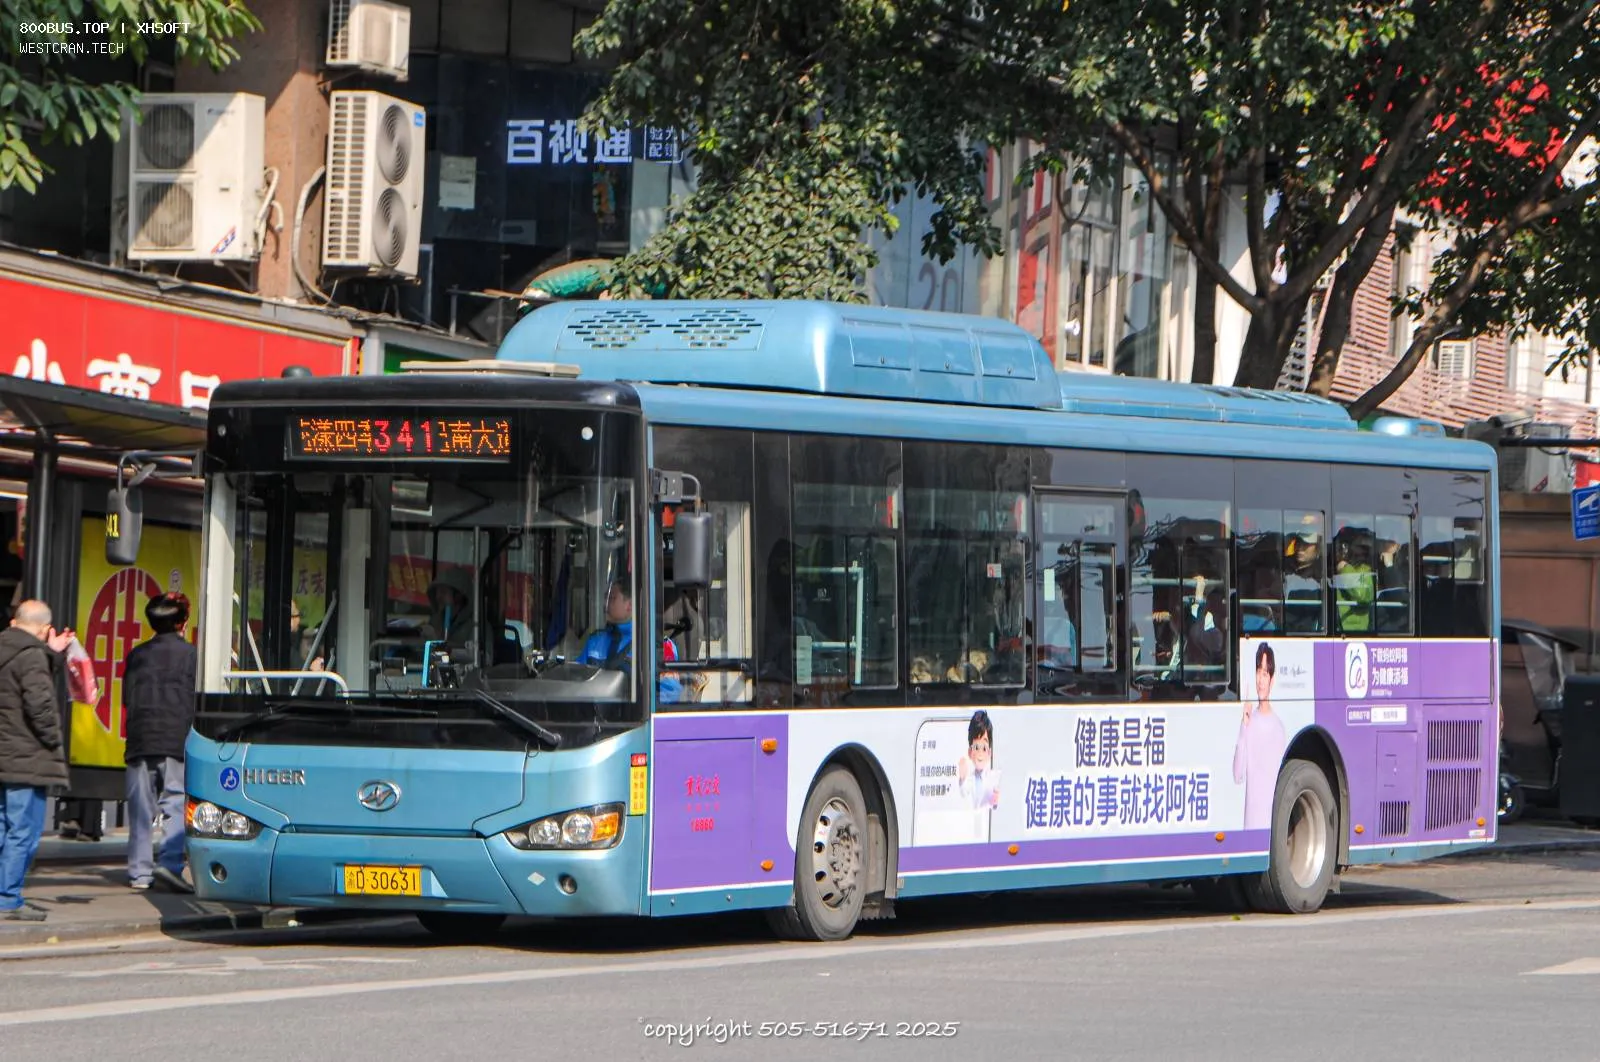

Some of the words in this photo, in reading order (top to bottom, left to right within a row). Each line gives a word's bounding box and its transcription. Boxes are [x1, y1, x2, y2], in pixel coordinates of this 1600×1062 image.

[506, 119, 632, 164] 百视通
[373, 420, 433, 452] 341
[105, 514, 119, 538] 41
[1074, 716, 1166, 768] 健康是福
[243, 767, 305, 785] HIGER
[1025, 772, 1210, 829] 健康的事就找阿福
